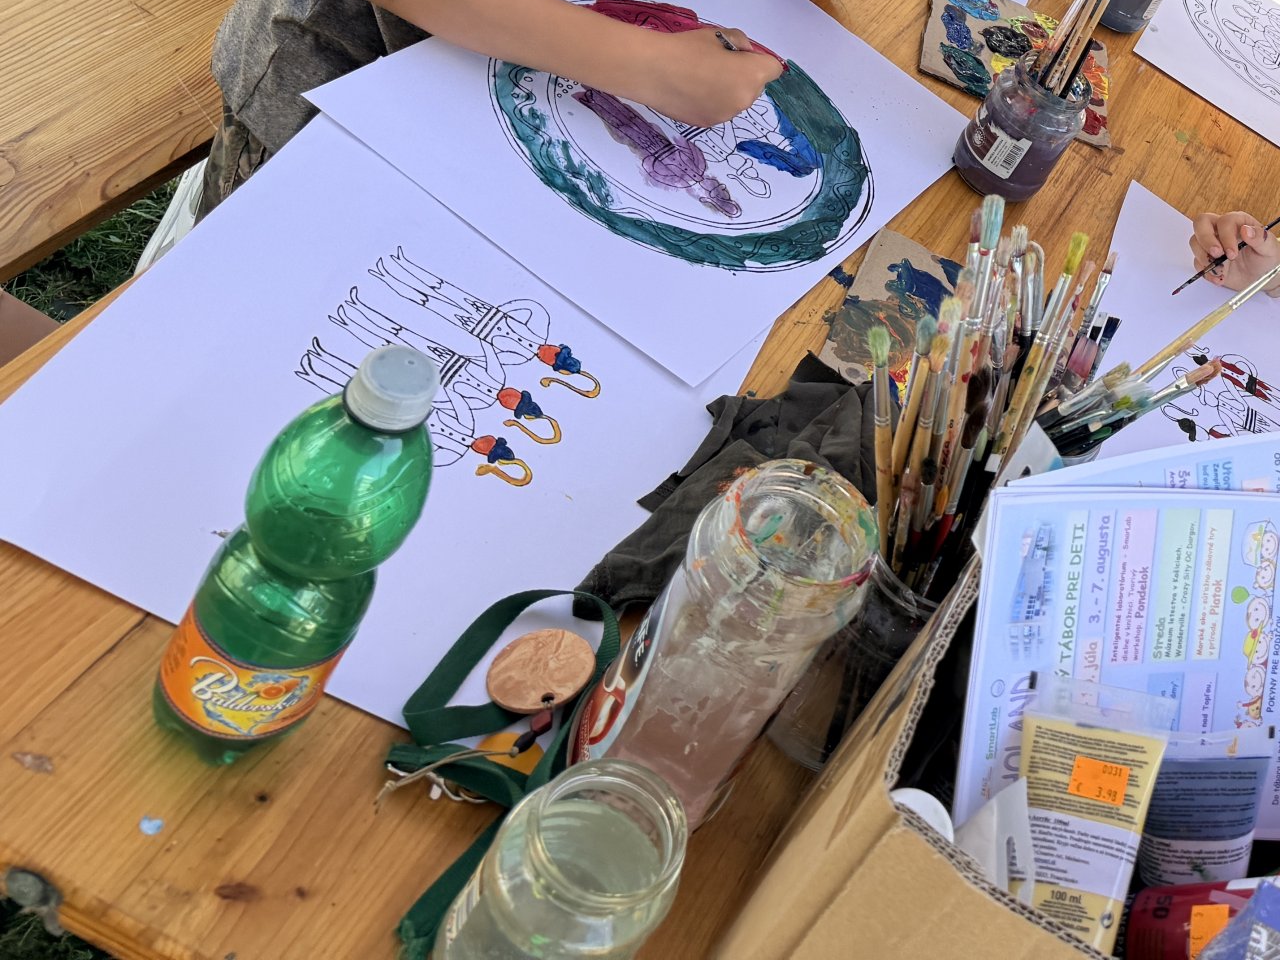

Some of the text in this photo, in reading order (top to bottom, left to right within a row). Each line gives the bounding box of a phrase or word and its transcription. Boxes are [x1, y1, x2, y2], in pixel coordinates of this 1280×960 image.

[1220, 460, 1235, 489] Utor
[1069, 523, 1083, 565] DETI
[1095, 514, 1113, 574] augusta
[1066, 570, 1078, 600] PRE
[1093, 578, 1103, 593] 7.
[1128, 568, 1137, 597] Tvorivý
[1135, 565, 1148, 618] Pondelok
[1181, 582, 1190, 604] Crazy
[1186, 550, 1192, 562] OC
[1110, 614, 1122, 662] Inteligentné
[1116, 561, 1127, 611] laboratórium
[1168, 592, 1176, 624] letectva
[1209, 578, 1222, 615] Piatok
[1090, 609, 1100, 623] 3.
[1056, 603, 1075, 662] TÁBOR
[1153, 616, 1165, 659] Streda
[1165, 627, 1173, 657] Múzeum
[1196, 627, 1204, 655] Morské
[1085, 640, 1100, 670] júla
[1269, 659, 1278, 674] PRE
[1265, 677, 1276, 713] POKYNY
[985, 706, 998, 760] SmartLab
[1101, 764, 1123, 778] 0031
[1096, 787, 1118, 802] 3.98
[1050, 890, 1082, 905] 100 ml
[1153, 895, 1173, 920] 50
